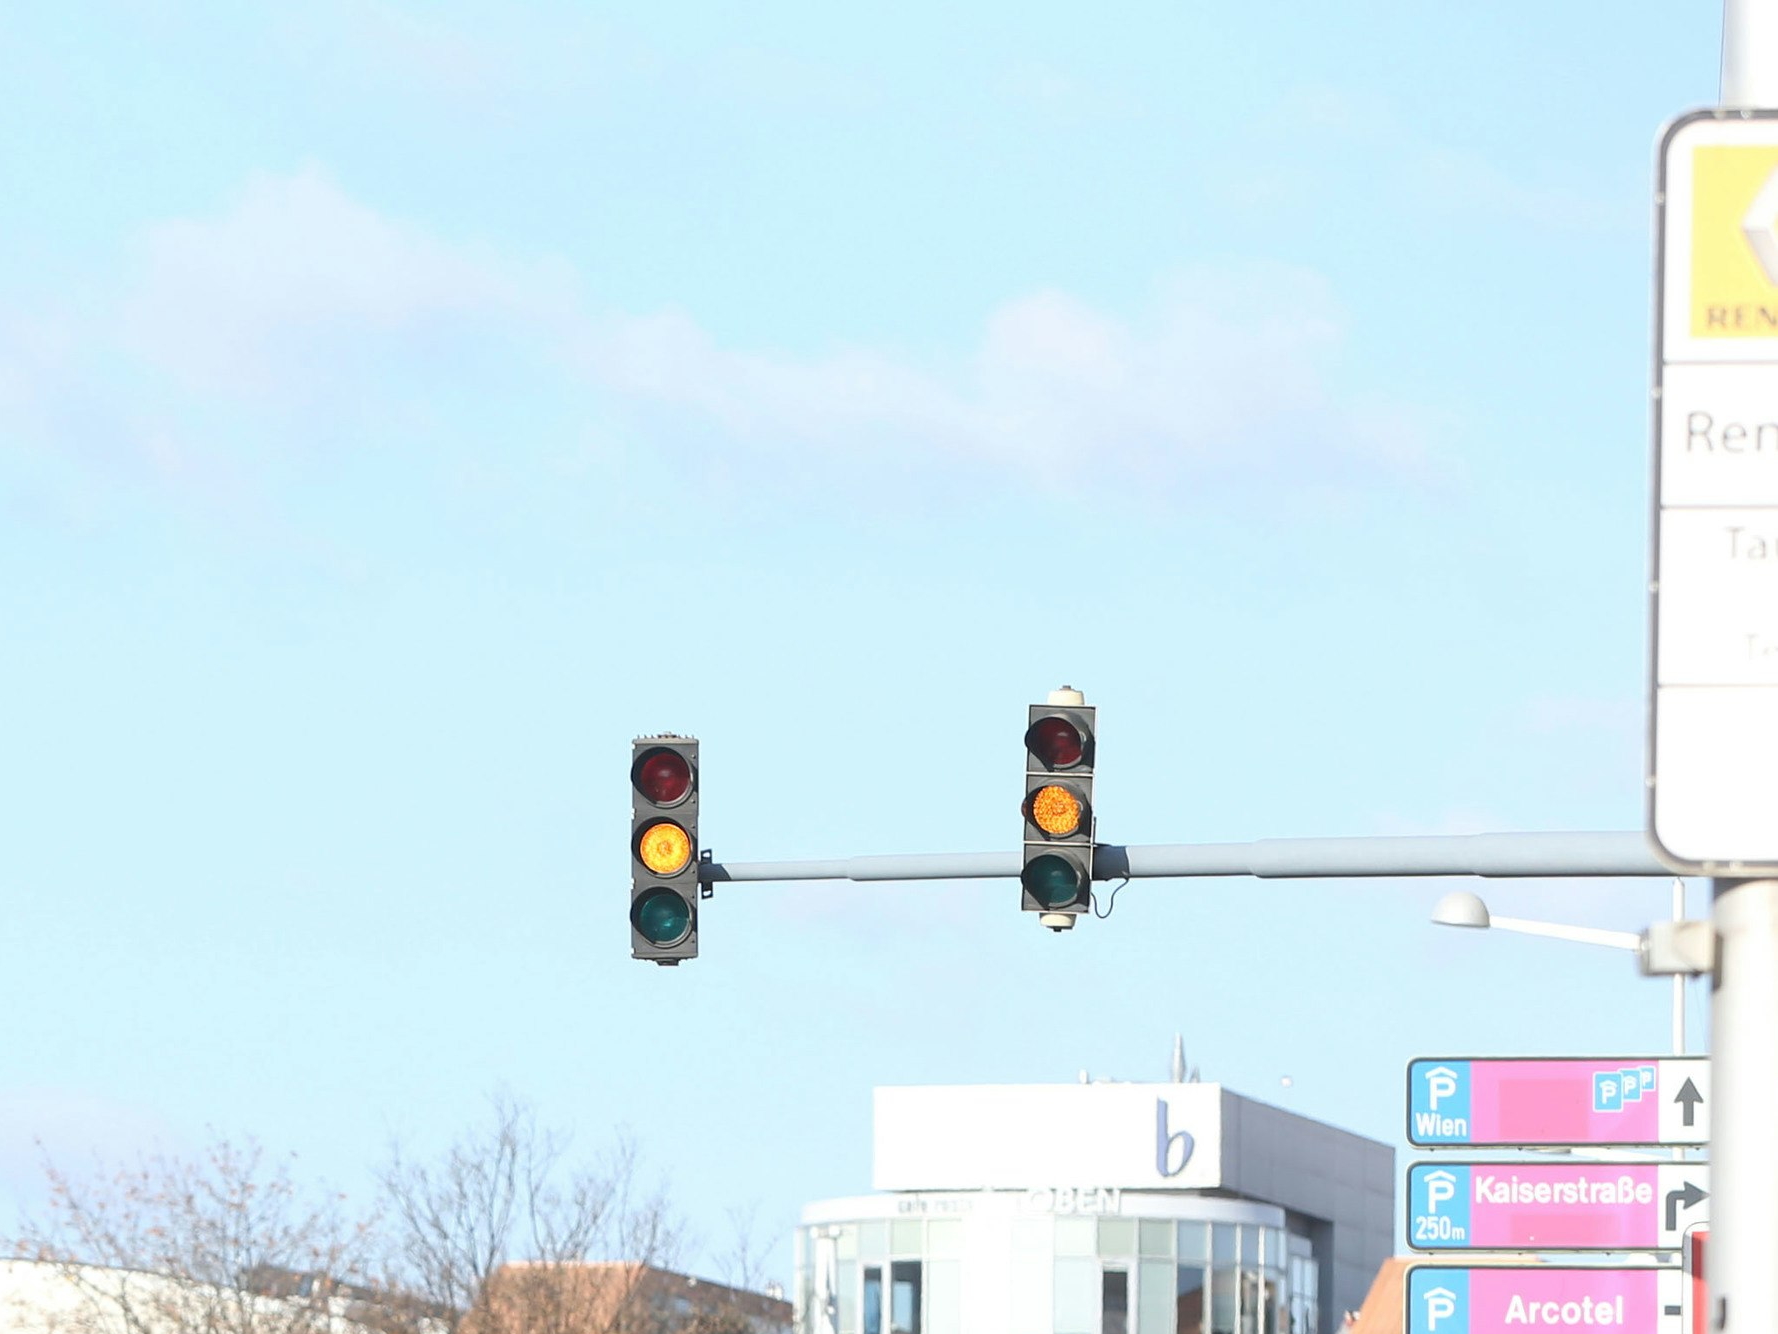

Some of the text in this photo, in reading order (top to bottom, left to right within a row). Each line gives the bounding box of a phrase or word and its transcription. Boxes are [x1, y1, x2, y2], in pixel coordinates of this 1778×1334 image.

[1686, 411, 1778, 452] Ren
[1725, 526, 1778, 559] Ta
[1156, 1096, 1195, 1178] b
[1415, 1112, 1467, 1137] Wien
[1475, 1175, 1652, 1205] Kaiserstraße
[1415, 1215, 1465, 1241] 250m
[1504, 1294, 1624, 1325] Arcotel
